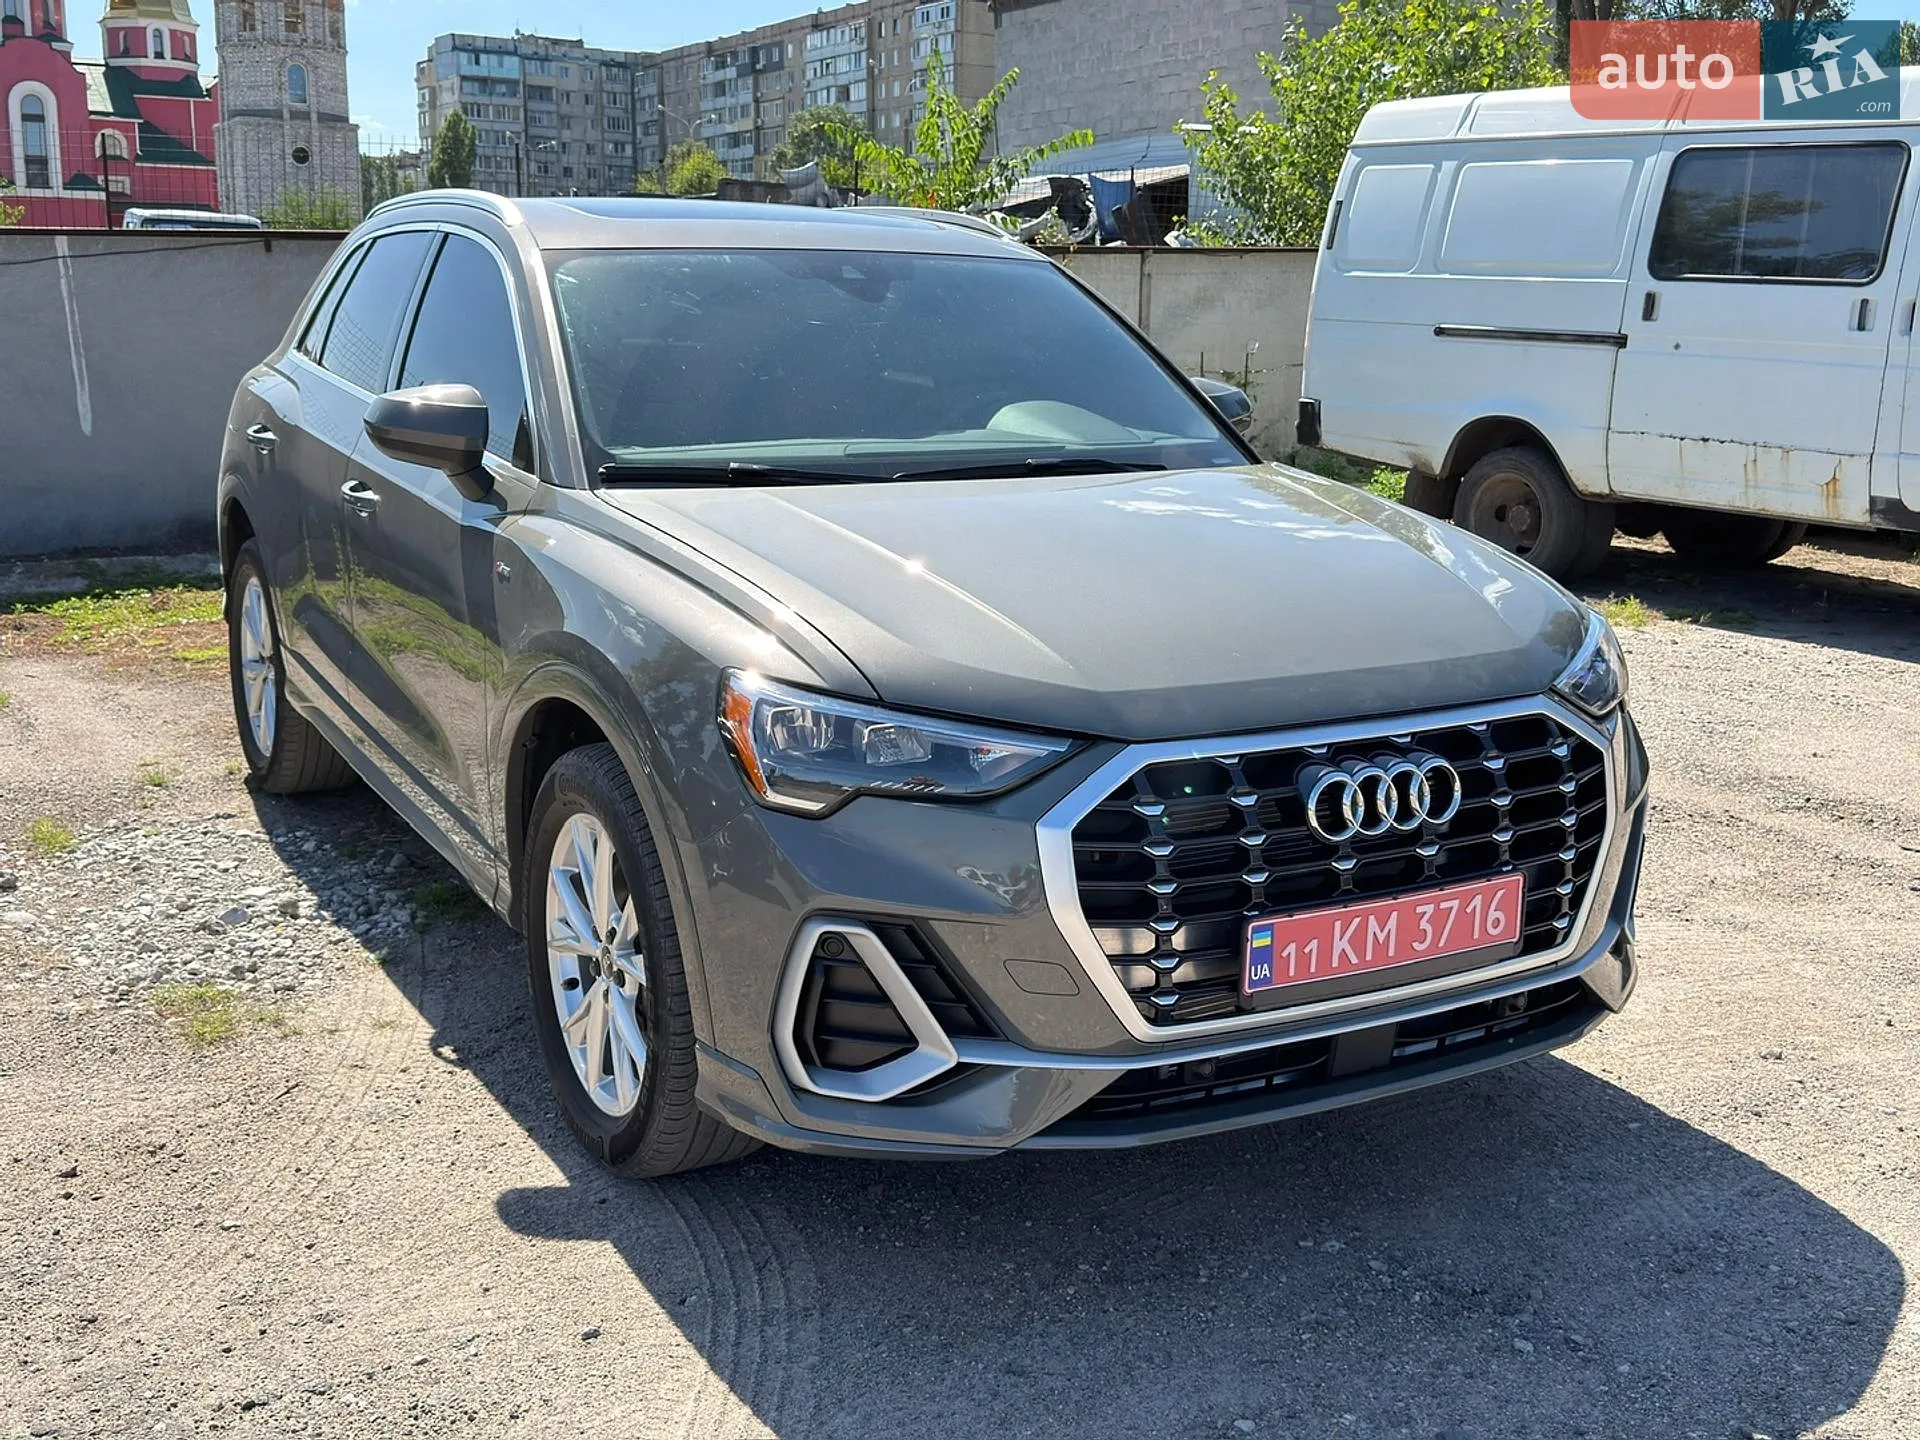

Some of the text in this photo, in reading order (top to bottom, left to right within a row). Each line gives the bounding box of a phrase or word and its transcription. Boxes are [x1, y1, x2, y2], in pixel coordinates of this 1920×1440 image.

[1280, 889, 1507, 977] 11 KM 3716
[1251, 963, 1271, 980] UA
